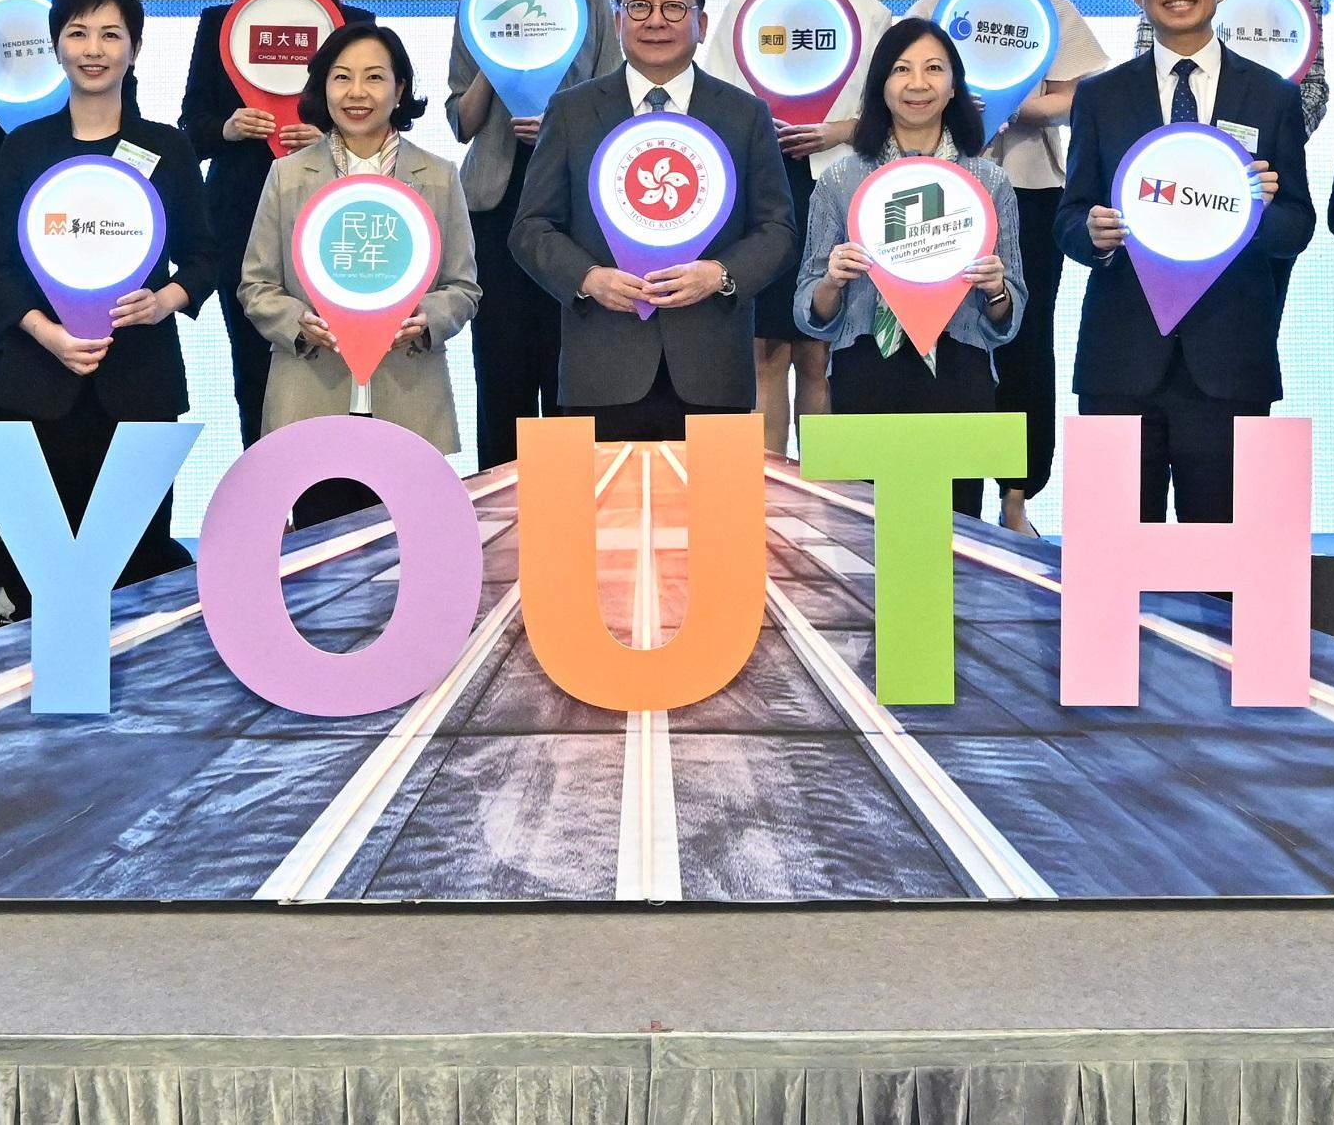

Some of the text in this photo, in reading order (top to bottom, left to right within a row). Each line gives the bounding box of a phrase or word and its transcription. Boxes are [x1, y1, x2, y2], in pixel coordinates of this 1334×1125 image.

[976, 20, 1029, 38] 蚂蚁集团
[2, 39, 45, 48] HENDERSON
[258, 31, 309, 47] 周大福
[761, 34, 784, 46] 美团
[791, 28, 836, 51] 美团
[974, 34, 1039, 49] ANT GROUP
[1180, 186, 1241, 213] SWIRE
[99, 220, 125, 228] China
[341, 211, 399, 242] 民政
[630, 210, 685, 228] HONG KONG
[99, 228, 144, 236] Resources
[329, 240, 389, 270] 青年
[890, 238, 957, 262] youth programme
